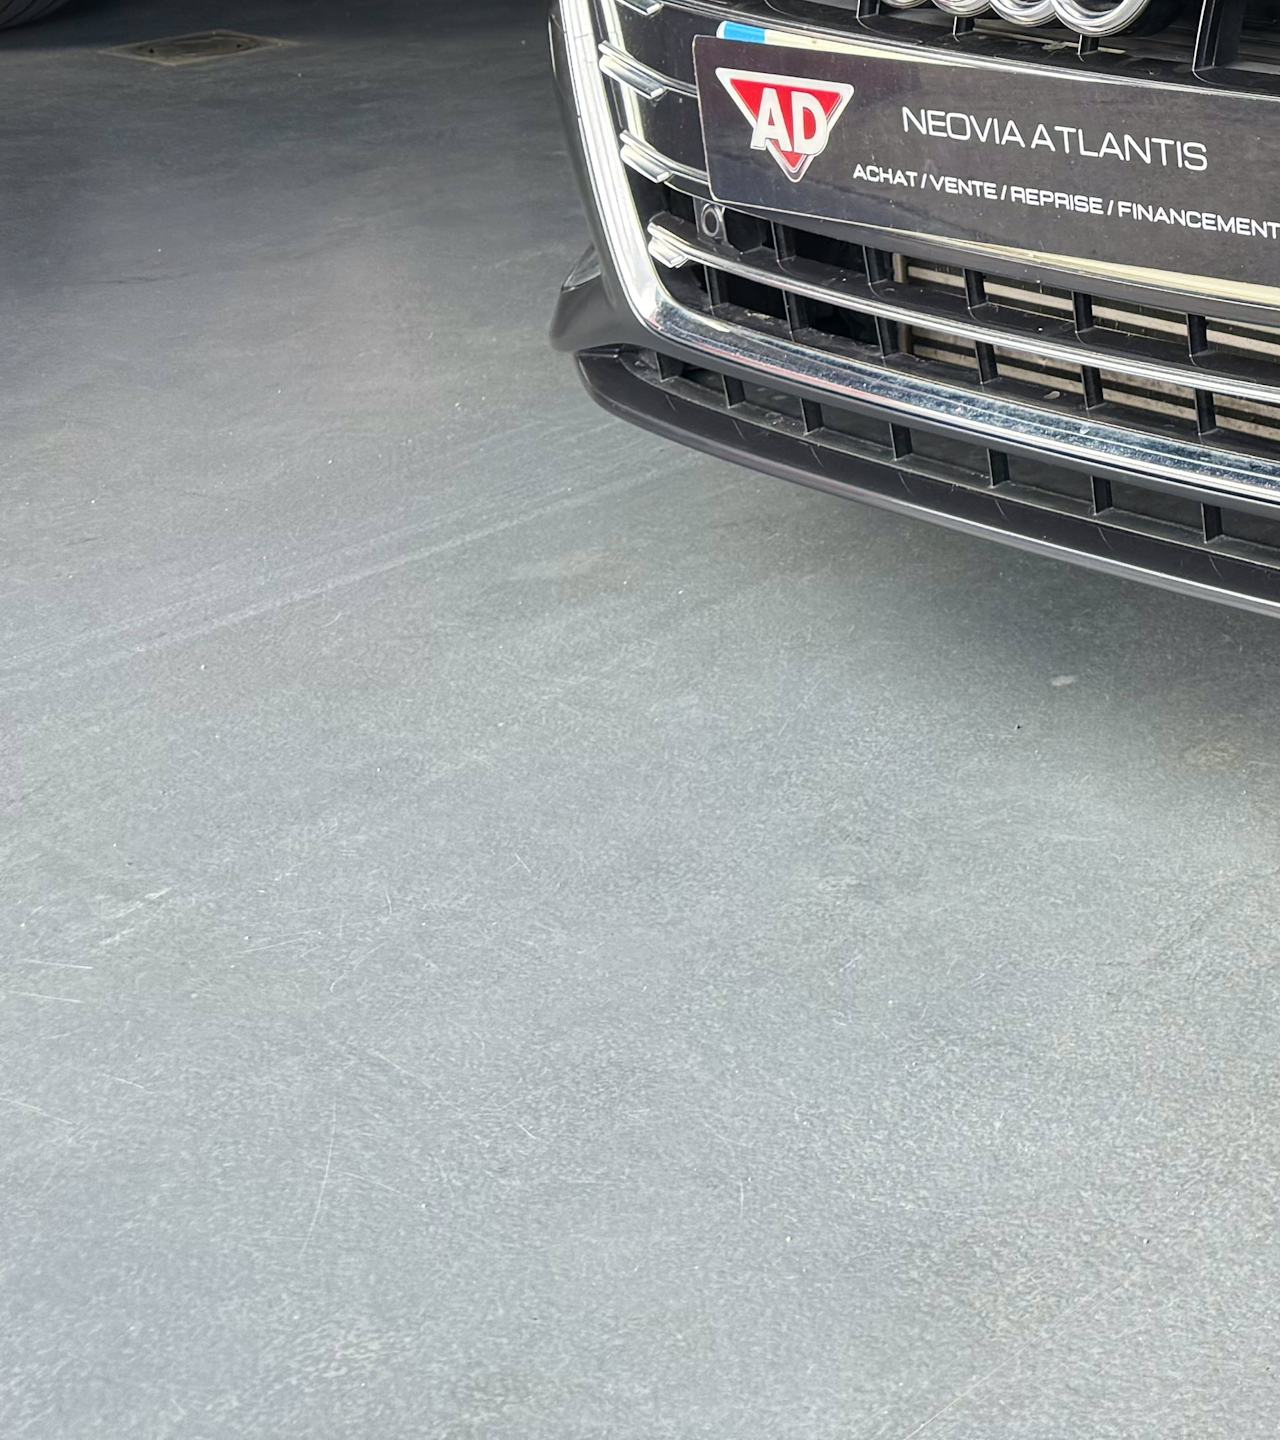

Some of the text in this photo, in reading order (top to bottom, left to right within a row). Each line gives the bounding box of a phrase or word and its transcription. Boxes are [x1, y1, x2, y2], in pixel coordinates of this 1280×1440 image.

[750, 87, 829, 156] AD
[902, 106, 1208, 171] NEOVIA ATLANTIS
[852, 163, 918, 187] ACHAT
[930, 174, 1000, 200] VENTE
[1010, 185, 1104, 215] REPRISE
[1117, 201, 1280, 240] FINANCEMENT
